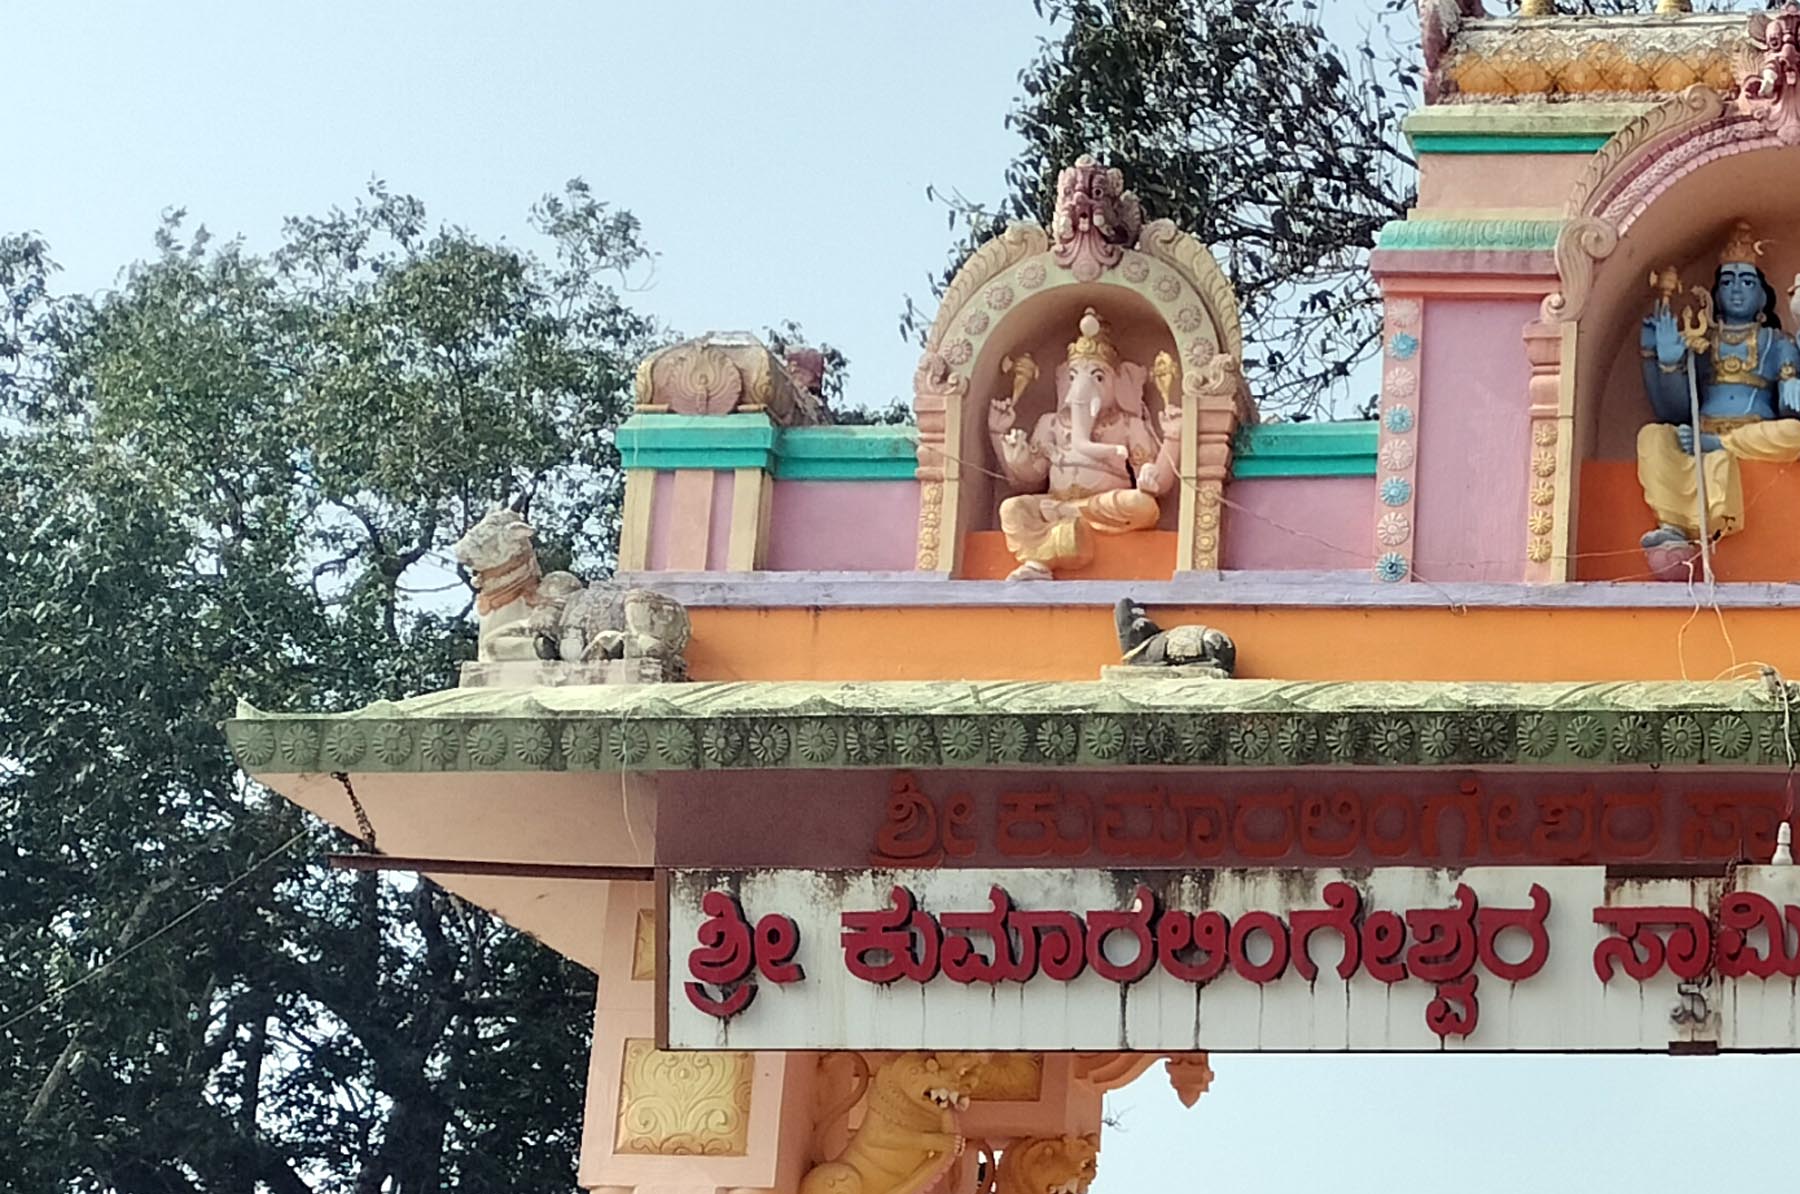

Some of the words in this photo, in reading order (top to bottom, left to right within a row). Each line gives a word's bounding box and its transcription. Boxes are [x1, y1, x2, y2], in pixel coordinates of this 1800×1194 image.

[869, 773, 978, 868] ಶ್ರೀ
[686, 891, 804, 1018] ಶ್ರೀ
[841, 883, 1550, 1036] ಕುಮಾರಲಿಂಗೇಶ್ವರ
